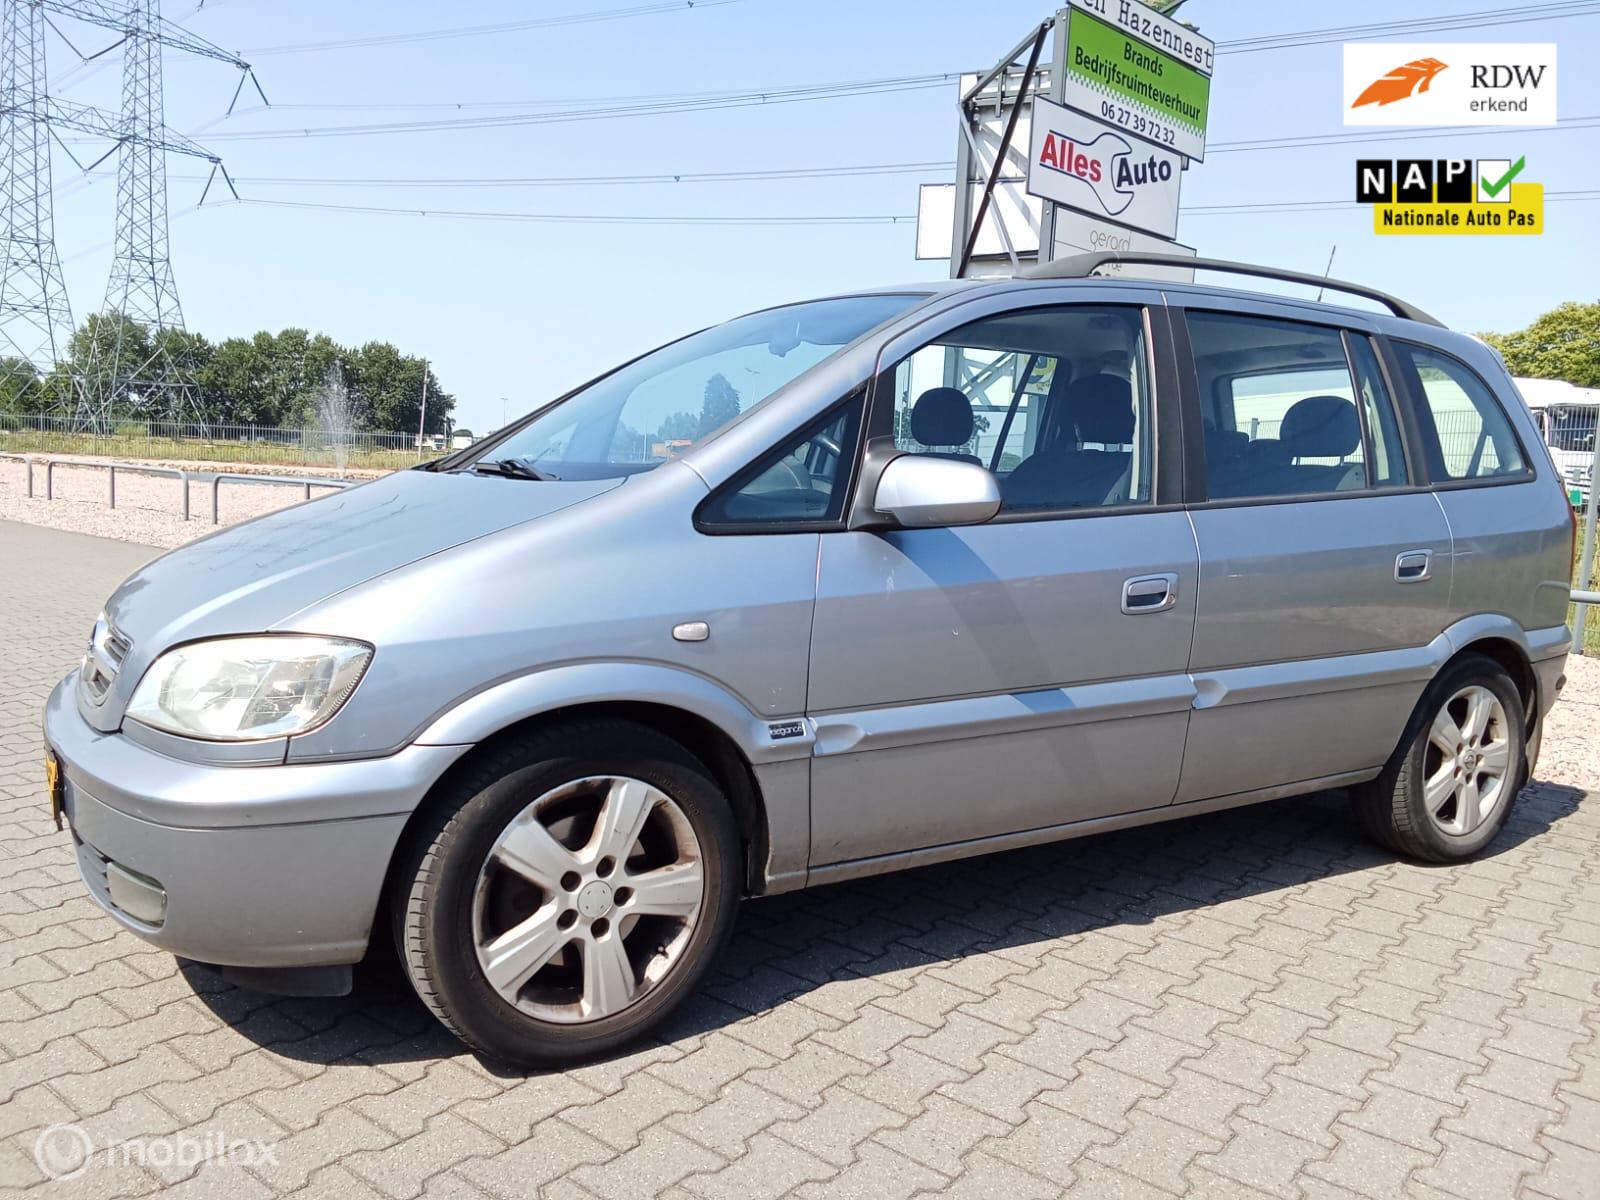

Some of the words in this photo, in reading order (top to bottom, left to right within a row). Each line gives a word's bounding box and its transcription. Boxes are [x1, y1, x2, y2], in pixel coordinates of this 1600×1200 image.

[1118, 0, 1212, 69] Hazennest
[1123, 41, 1163, 77] Brands
[1075, 45, 1201, 121] Bedrijfsruimteverhuur
[1101, 100, 1115, 120] 06
[1118, 107, 1131, 126] 27
[1133, 114, 1146, 132] 39
[1148, 121, 1161, 140] 72
[1163, 127, 1175, 146] 32
[1040, 133, 1102, 182] Alles
[1116, 155, 1171, 188] Auto
